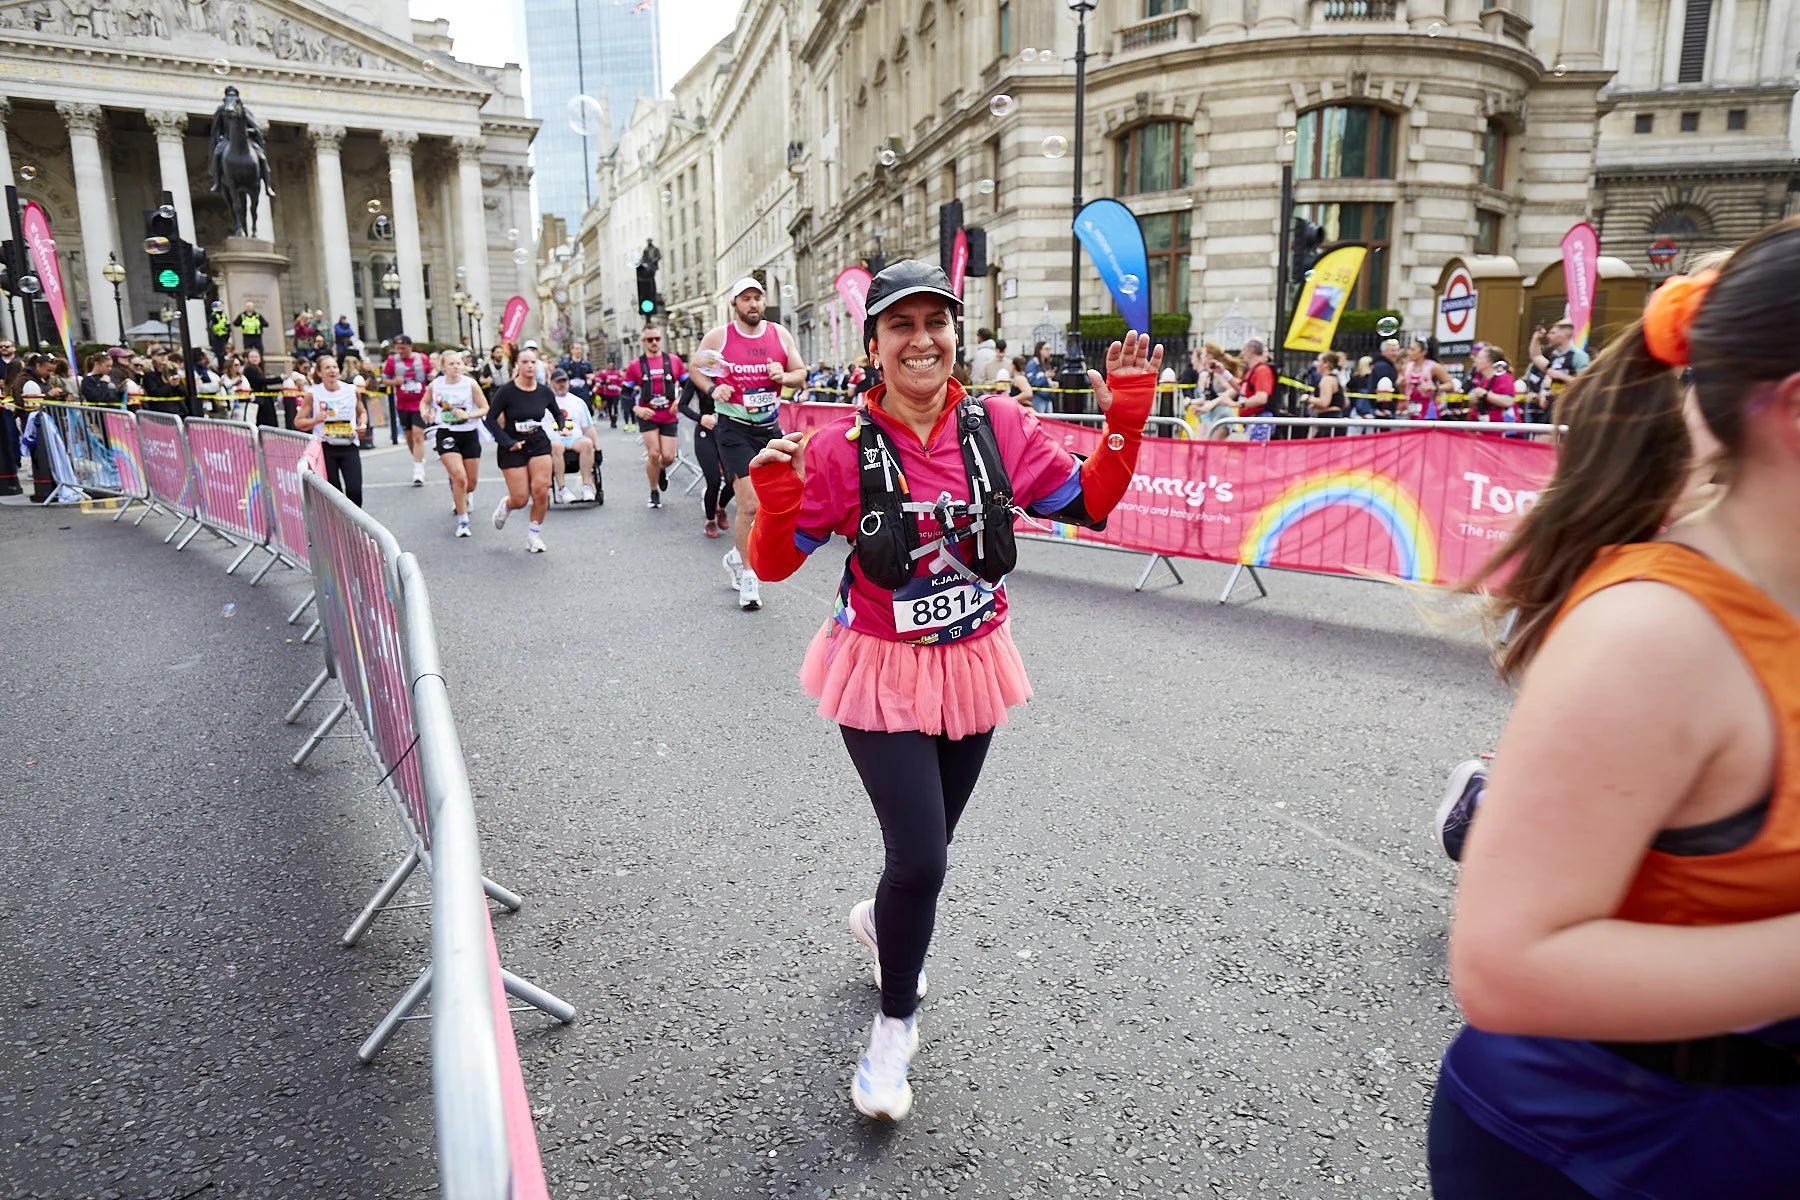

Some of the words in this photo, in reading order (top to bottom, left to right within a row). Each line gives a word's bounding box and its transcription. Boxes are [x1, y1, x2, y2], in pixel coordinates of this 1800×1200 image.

[728, 362, 769, 374] Tomm
[749, 393, 774, 405] 9369
[1129, 472, 1233, 507] mmy's
[1116, 501, 1149, 516] nancy
[1150, 506, 1169, 517] and
[1170, 508, 1195, 521] baby
[1460, 522, 1484, 538] The
[1485, 528, 1512, 541] pre
[912, 588, 983, 626] 8814
